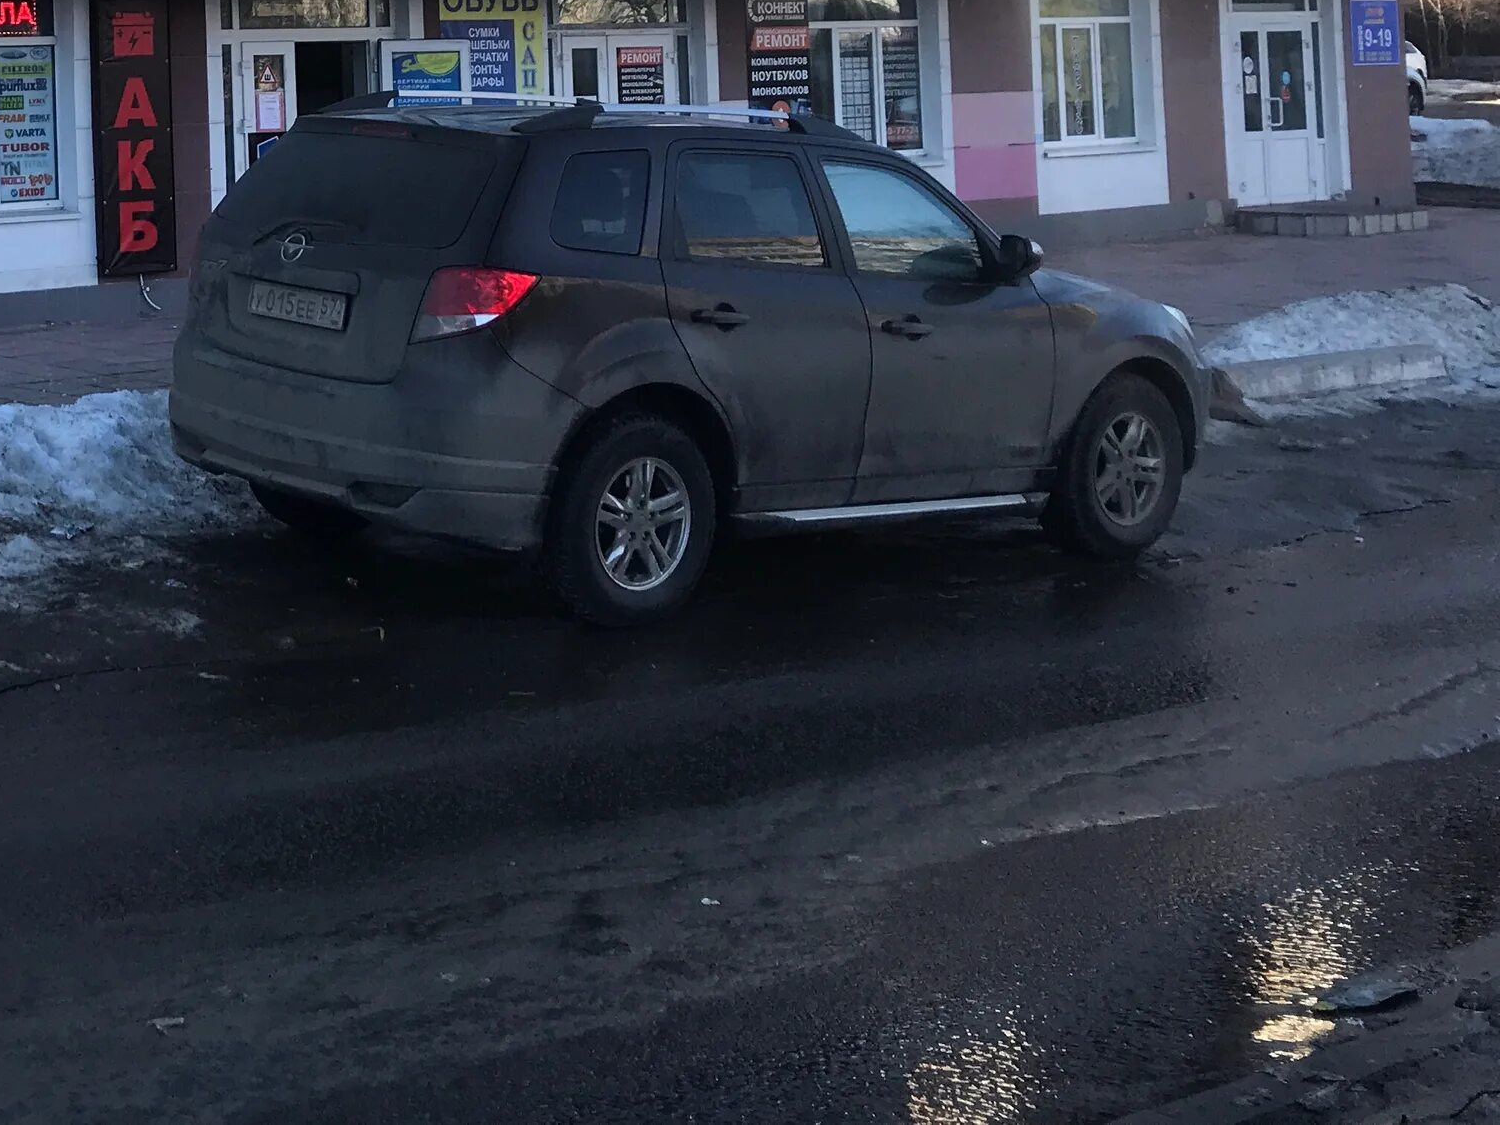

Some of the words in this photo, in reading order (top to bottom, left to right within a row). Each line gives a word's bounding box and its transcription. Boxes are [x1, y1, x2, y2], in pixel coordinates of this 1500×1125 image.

[757, 1, 805, 14] КОННЕКТ
[468, 27, 500, 38] СУМКИ
[1365, 29, 1392, 47] 9-19
[471, 39, 510, 50] ШЕЛЬКИ
[756, 34, 807, 48] РЕМОНТ
[521, 21, 537, 95] САП
[621, 53, 661, 64] РЕМОНТ
[751, 56, 808, 66] КОМПЬЮТЕРОВ
[751, 69, 809, 82] НОУТБУКОВ
[752, 86, 810, 97] МОНОБЛОКОВ
[15, 128, 46, 137] VARTA
[0, 142, 50, 152] TUBOR
[114, 76, 159, 254] АКБ
[19, 187, 45, 197] EXIDE
